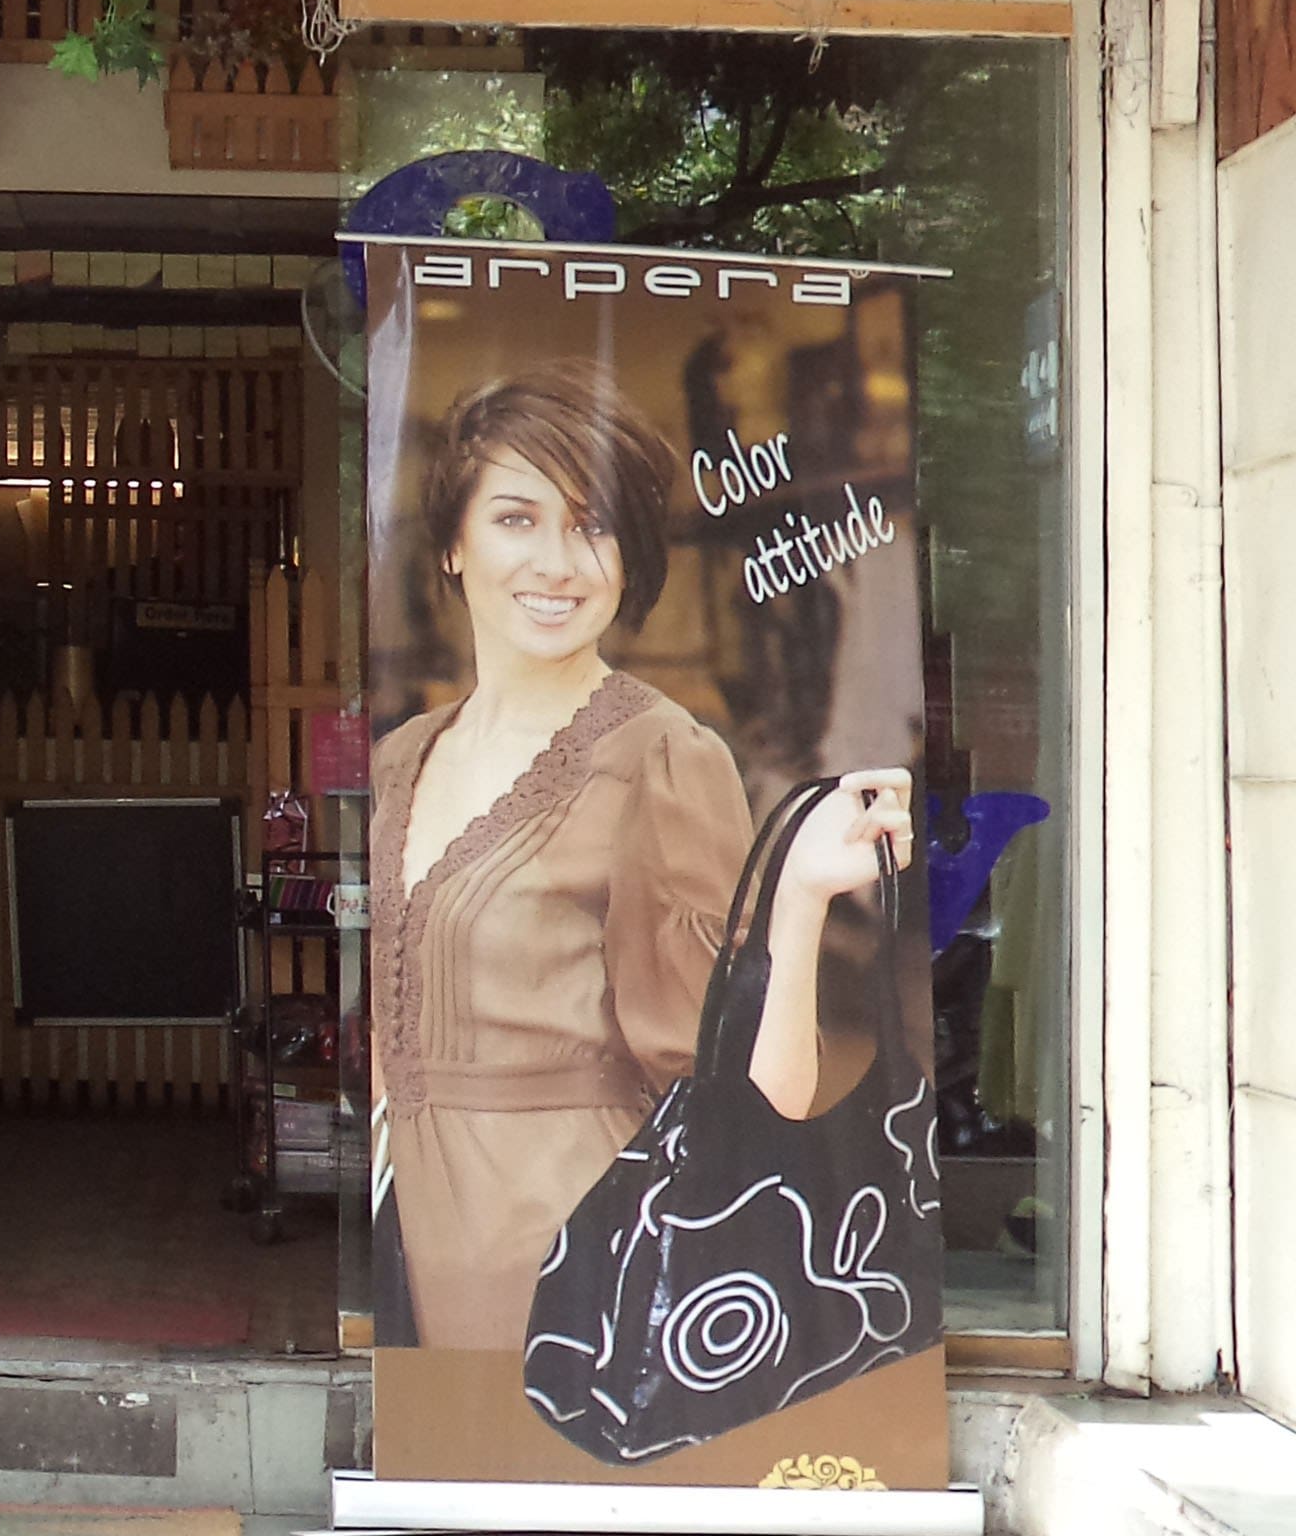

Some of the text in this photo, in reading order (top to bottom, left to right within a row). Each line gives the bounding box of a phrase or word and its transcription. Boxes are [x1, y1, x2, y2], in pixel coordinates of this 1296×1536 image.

[414, 255, 852, 306] arpera
[692, 428, 792, 517] Color
[744, 482, 895, 604] attitude
